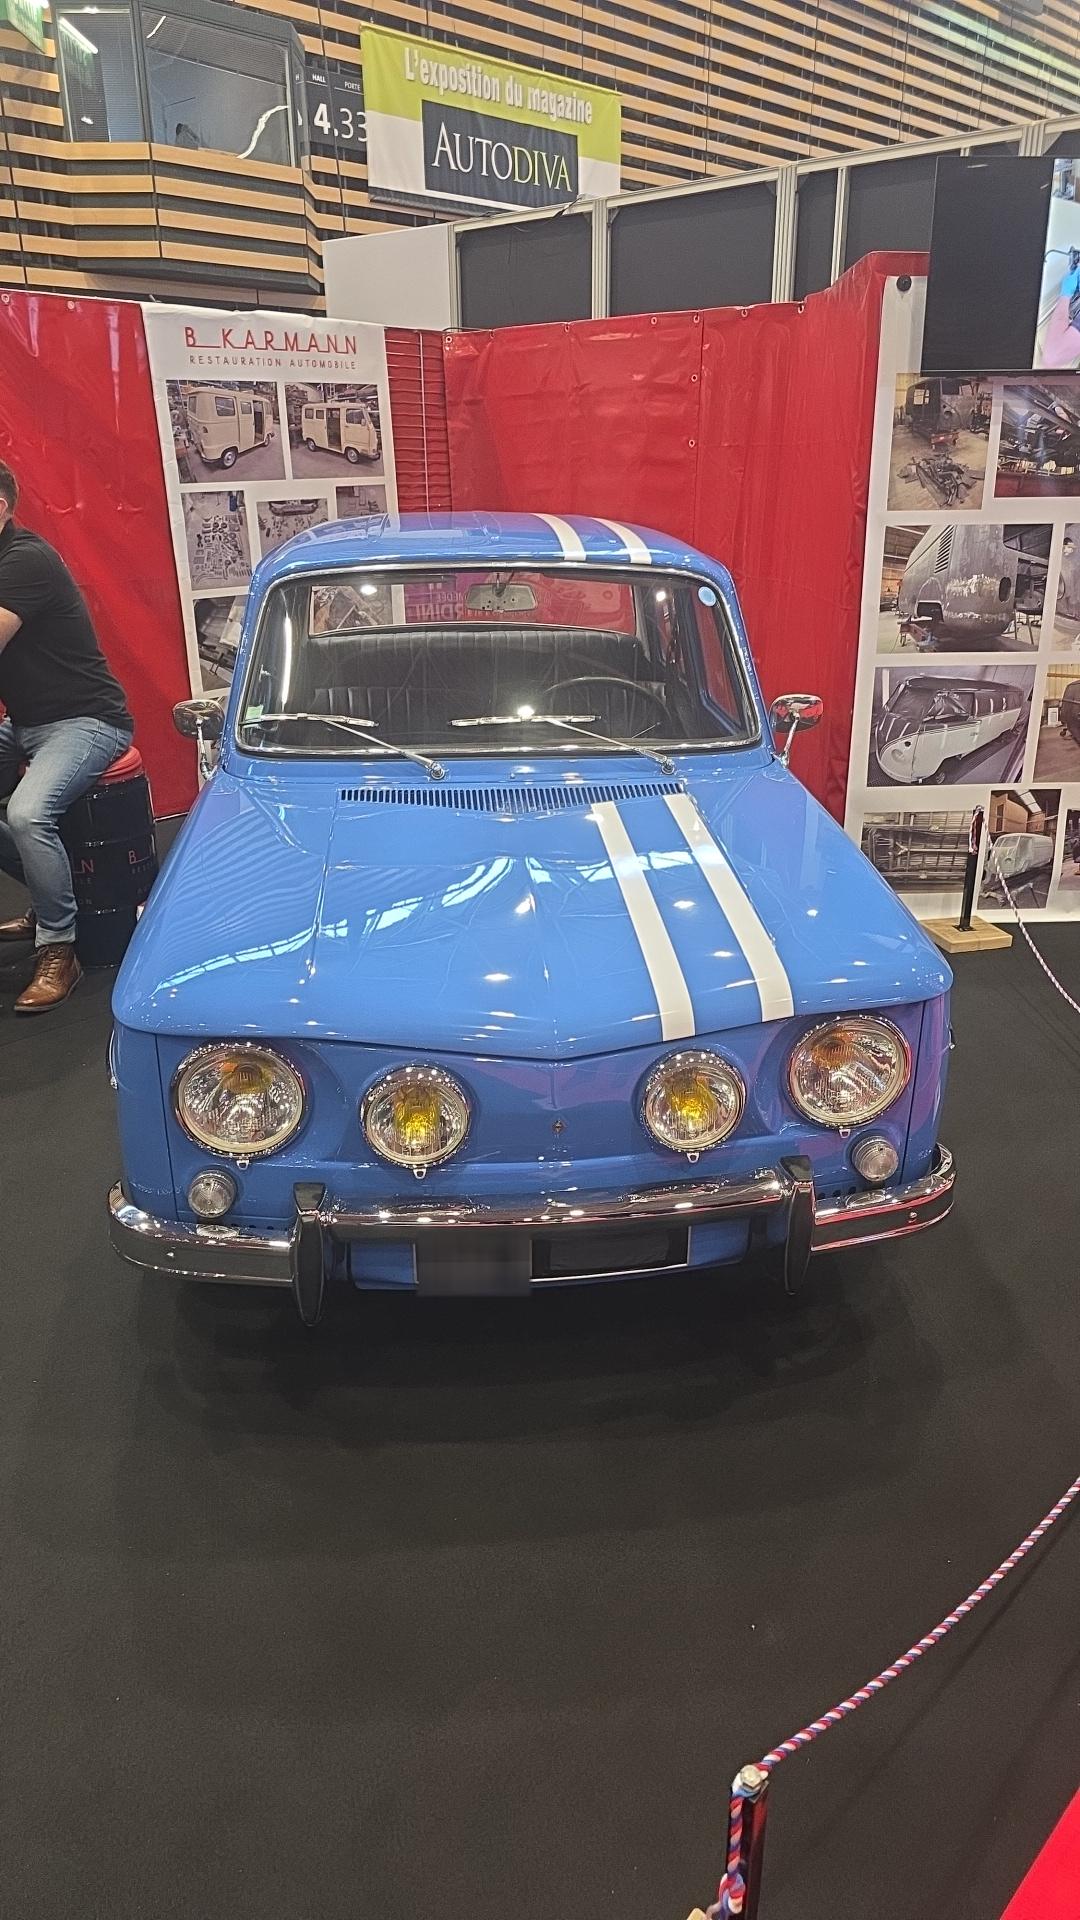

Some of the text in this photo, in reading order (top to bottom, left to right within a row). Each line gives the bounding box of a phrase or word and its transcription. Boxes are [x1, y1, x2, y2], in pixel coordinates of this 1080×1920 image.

[312, 73, 326, 83] HALL
[344, 81, 361, 91] PORTE
[404, 47, 593, 125] L'exposition du magazine
[431, 121, 573, 193] AUTODIVA
[221, 328, 357, 355] KARMANN
[189, 355, 356, 370] RESTAURATION AUTOMOBILE
